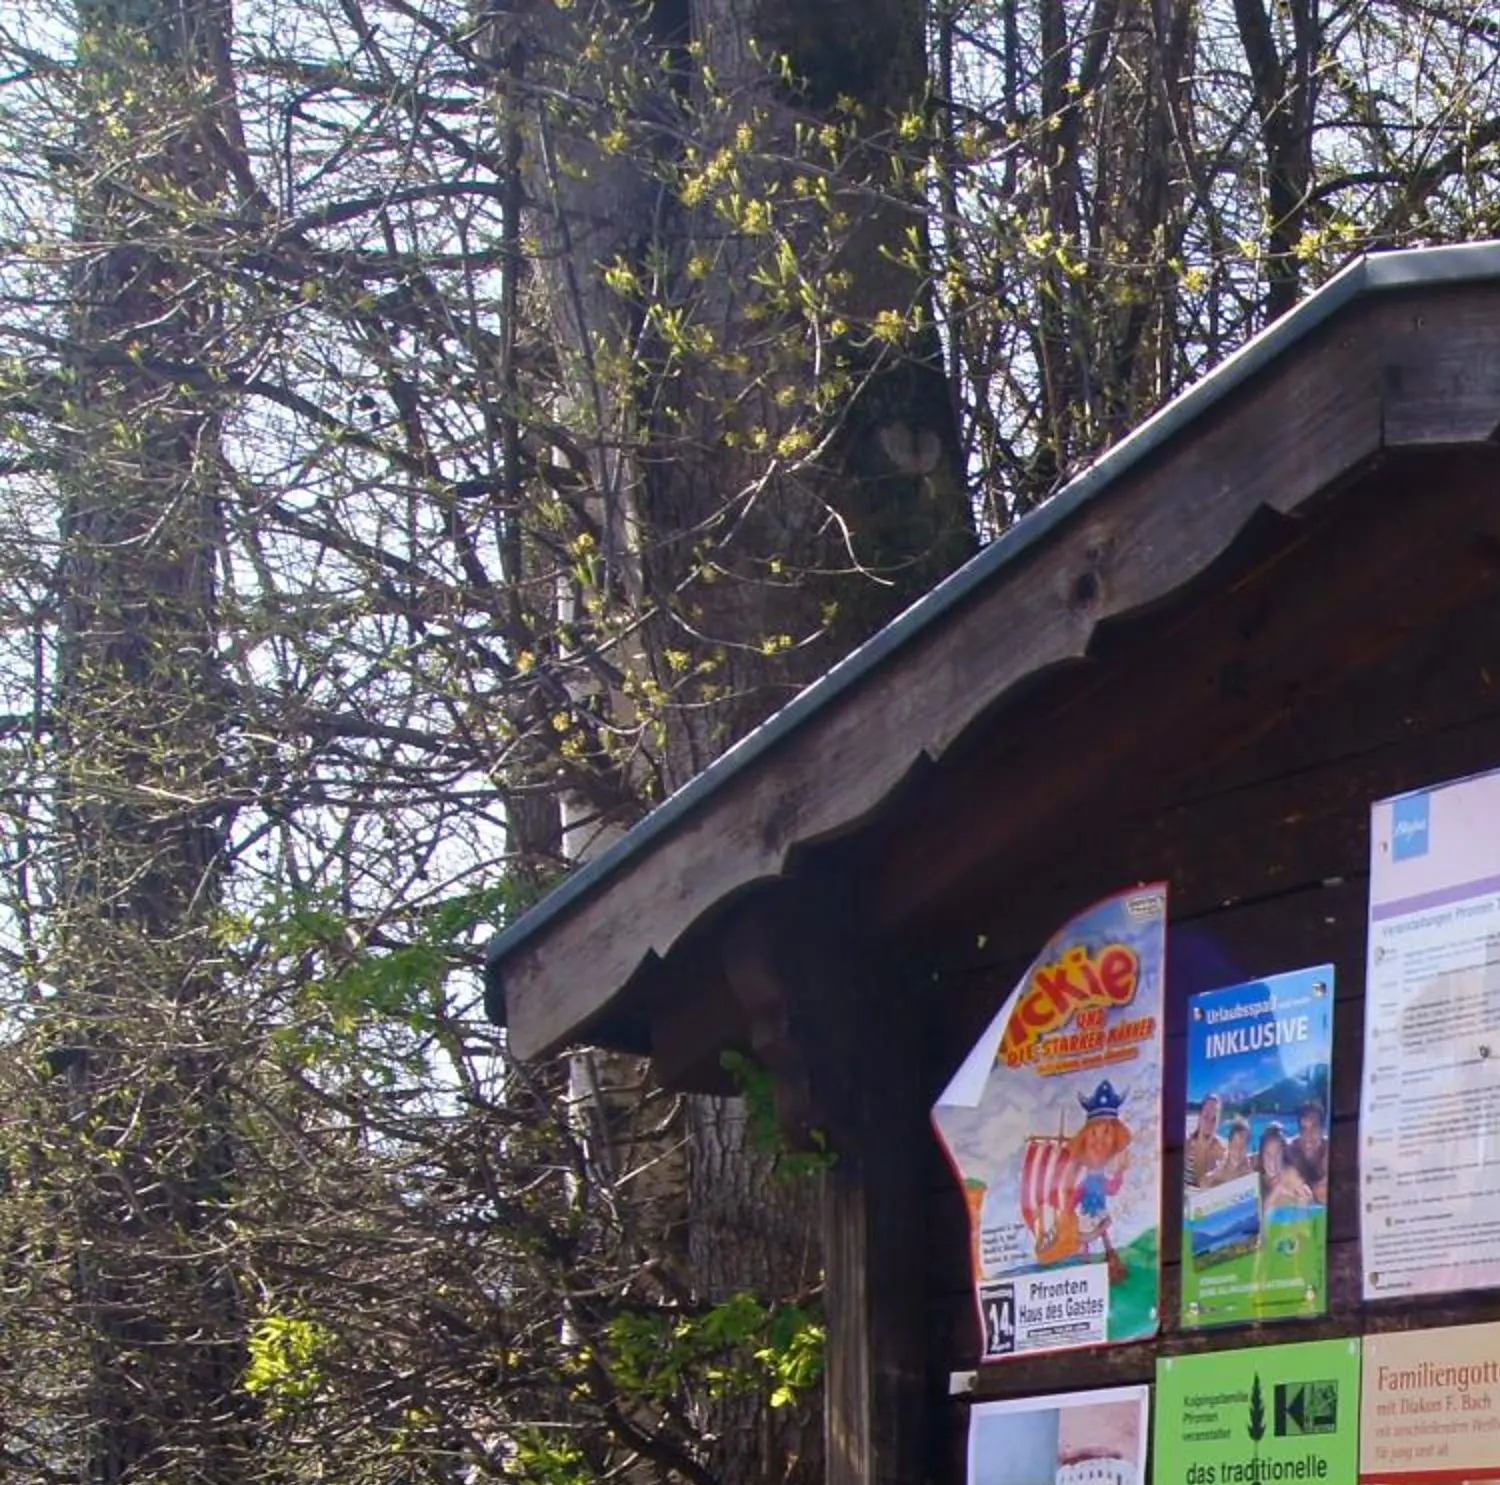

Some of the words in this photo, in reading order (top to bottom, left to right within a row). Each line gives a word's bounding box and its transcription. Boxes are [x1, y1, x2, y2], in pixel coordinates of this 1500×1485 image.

[1205, 1015, 1309, 1060] INKLUSIVE
[1030, 1279, 1089, 1300] Pfronten
[1066, 1297, 1105, 1317] Gastes
[1376, 1402, 1396, 1416] mit
[1400, 1398, 1442, 1414] Diakon
[1461, 1394, 1491, 1411] Bach
[1186, 1462, 1216, 1485] das
[1221, 1454, 1328, 1483] traditionelle
